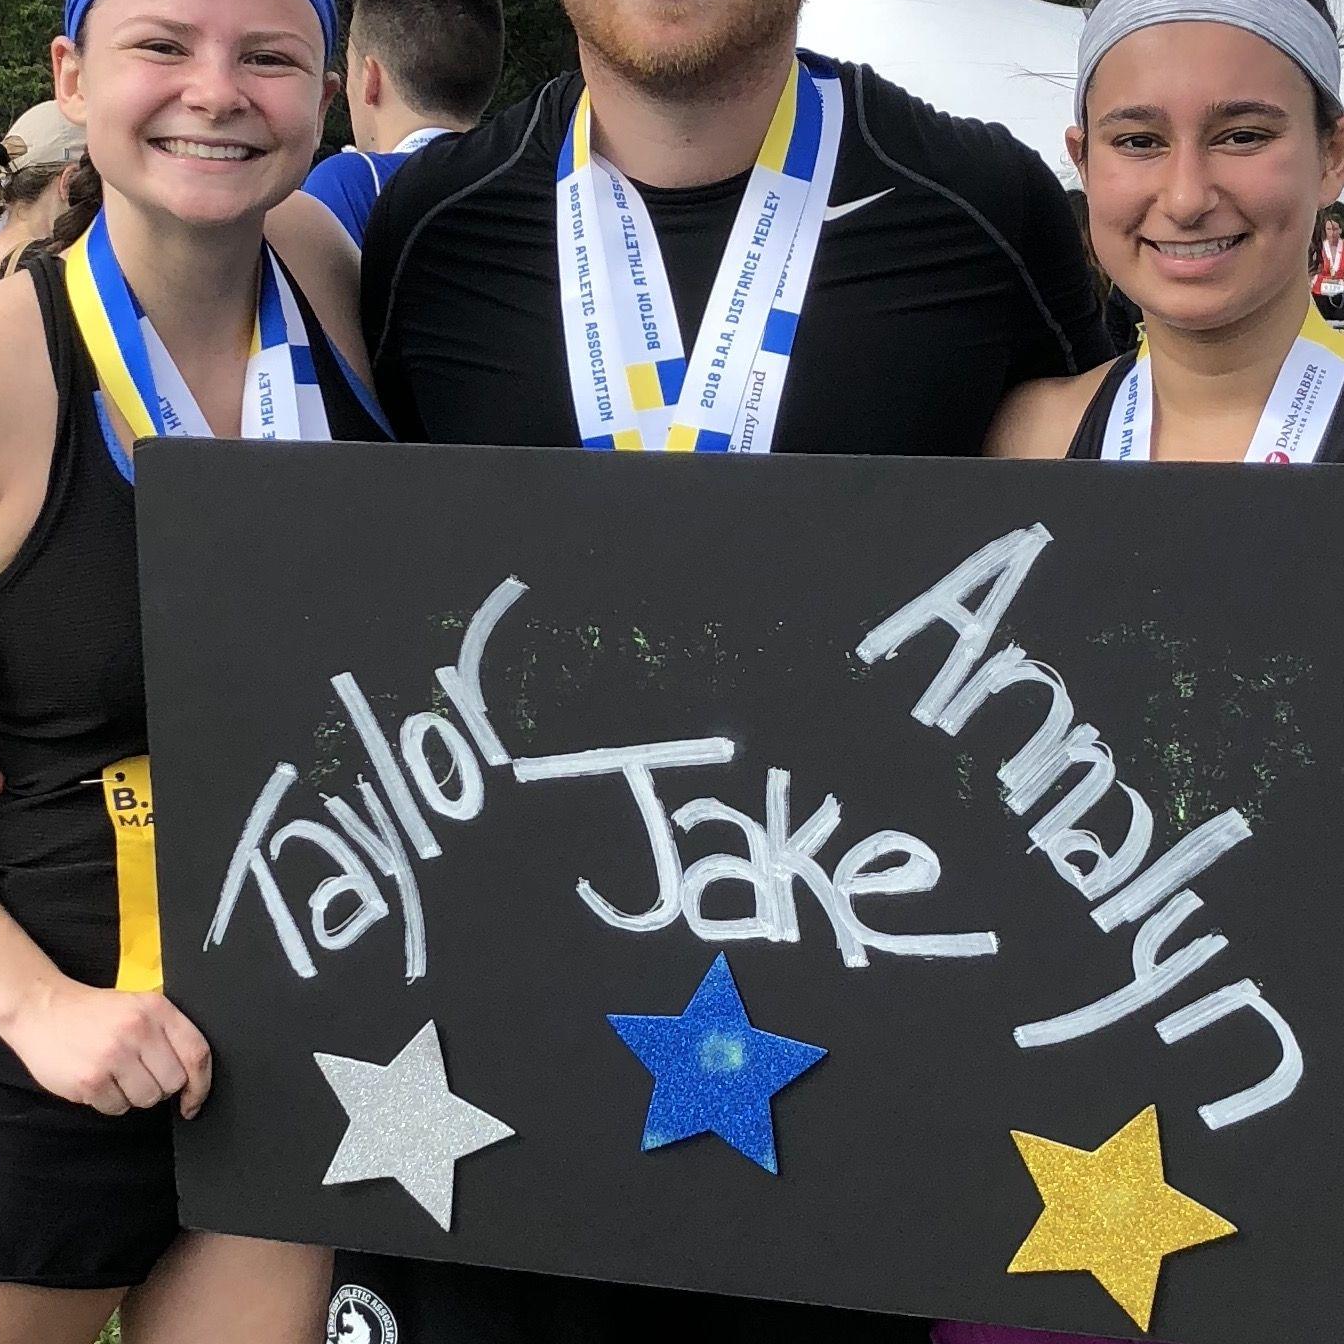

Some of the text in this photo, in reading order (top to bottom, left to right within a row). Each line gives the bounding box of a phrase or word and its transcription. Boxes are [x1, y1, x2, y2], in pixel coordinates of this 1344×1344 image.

[621, 214, 648, 287] ATHLETIC
[569, 182, 614, 423] BOSTON ATHLETIC ASSOCIATION
[637, 291, 661, 352] BOSTON
[700, 190, 781, 409] 2018 B.A.A. DISTANCE MEDLEY
[258, 371, 275, 427] MEDLEY
[745, 370, 767, 411] Fund
[1123, 374, 1139, 425] BOSTON
[1276, 363, 1319, 449] DANA-FARBER
[1289, 368, 1327, 452] CANCER INSTITUTE
[202, 574, 531, 984] Taylor
[513, 737, 1000, 969] Jake
[855, 522, 1306, 1132] Annalyn
